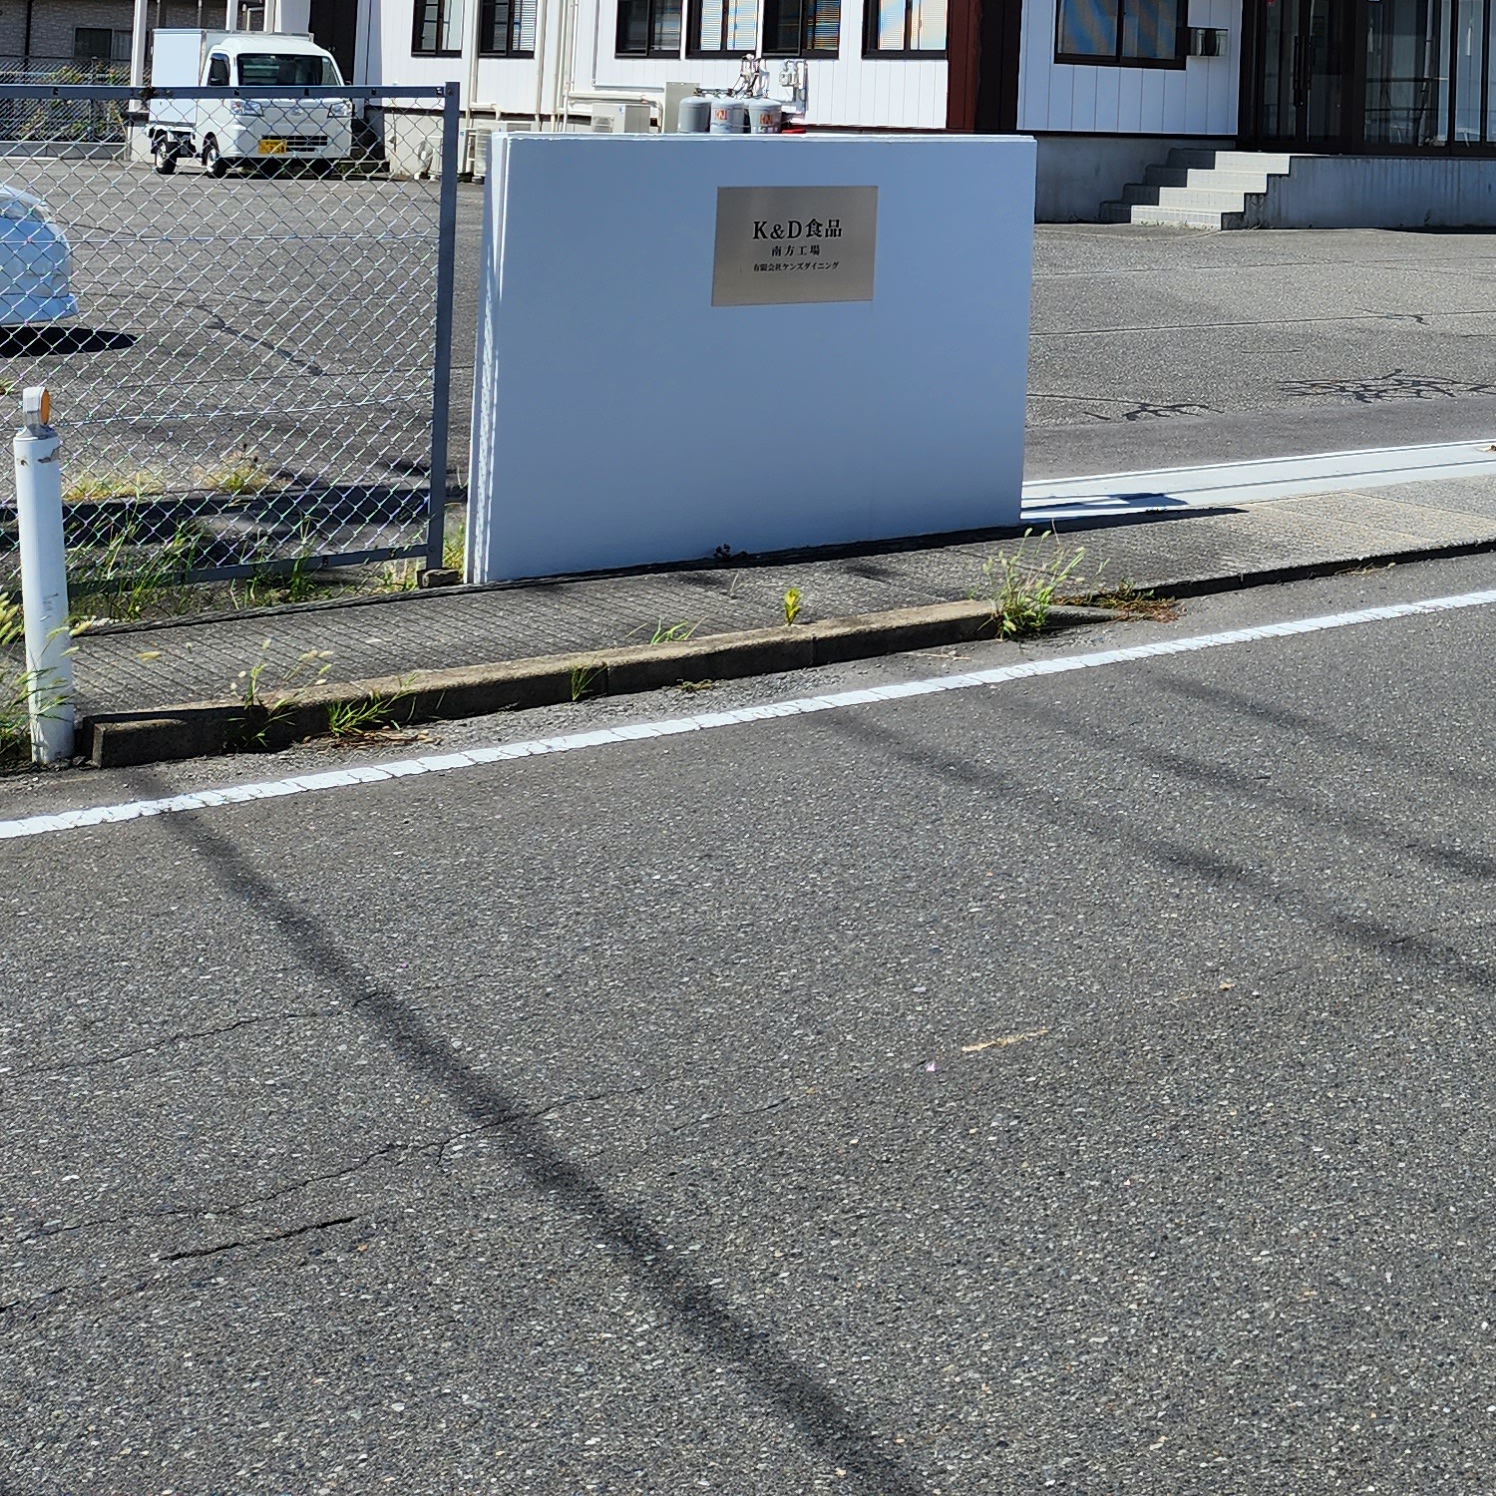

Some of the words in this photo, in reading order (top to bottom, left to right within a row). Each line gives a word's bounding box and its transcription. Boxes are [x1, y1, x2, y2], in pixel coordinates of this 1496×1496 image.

[752, 218, 843, 240] K&D食品
[771, 244, 821, 257] 南方工場
